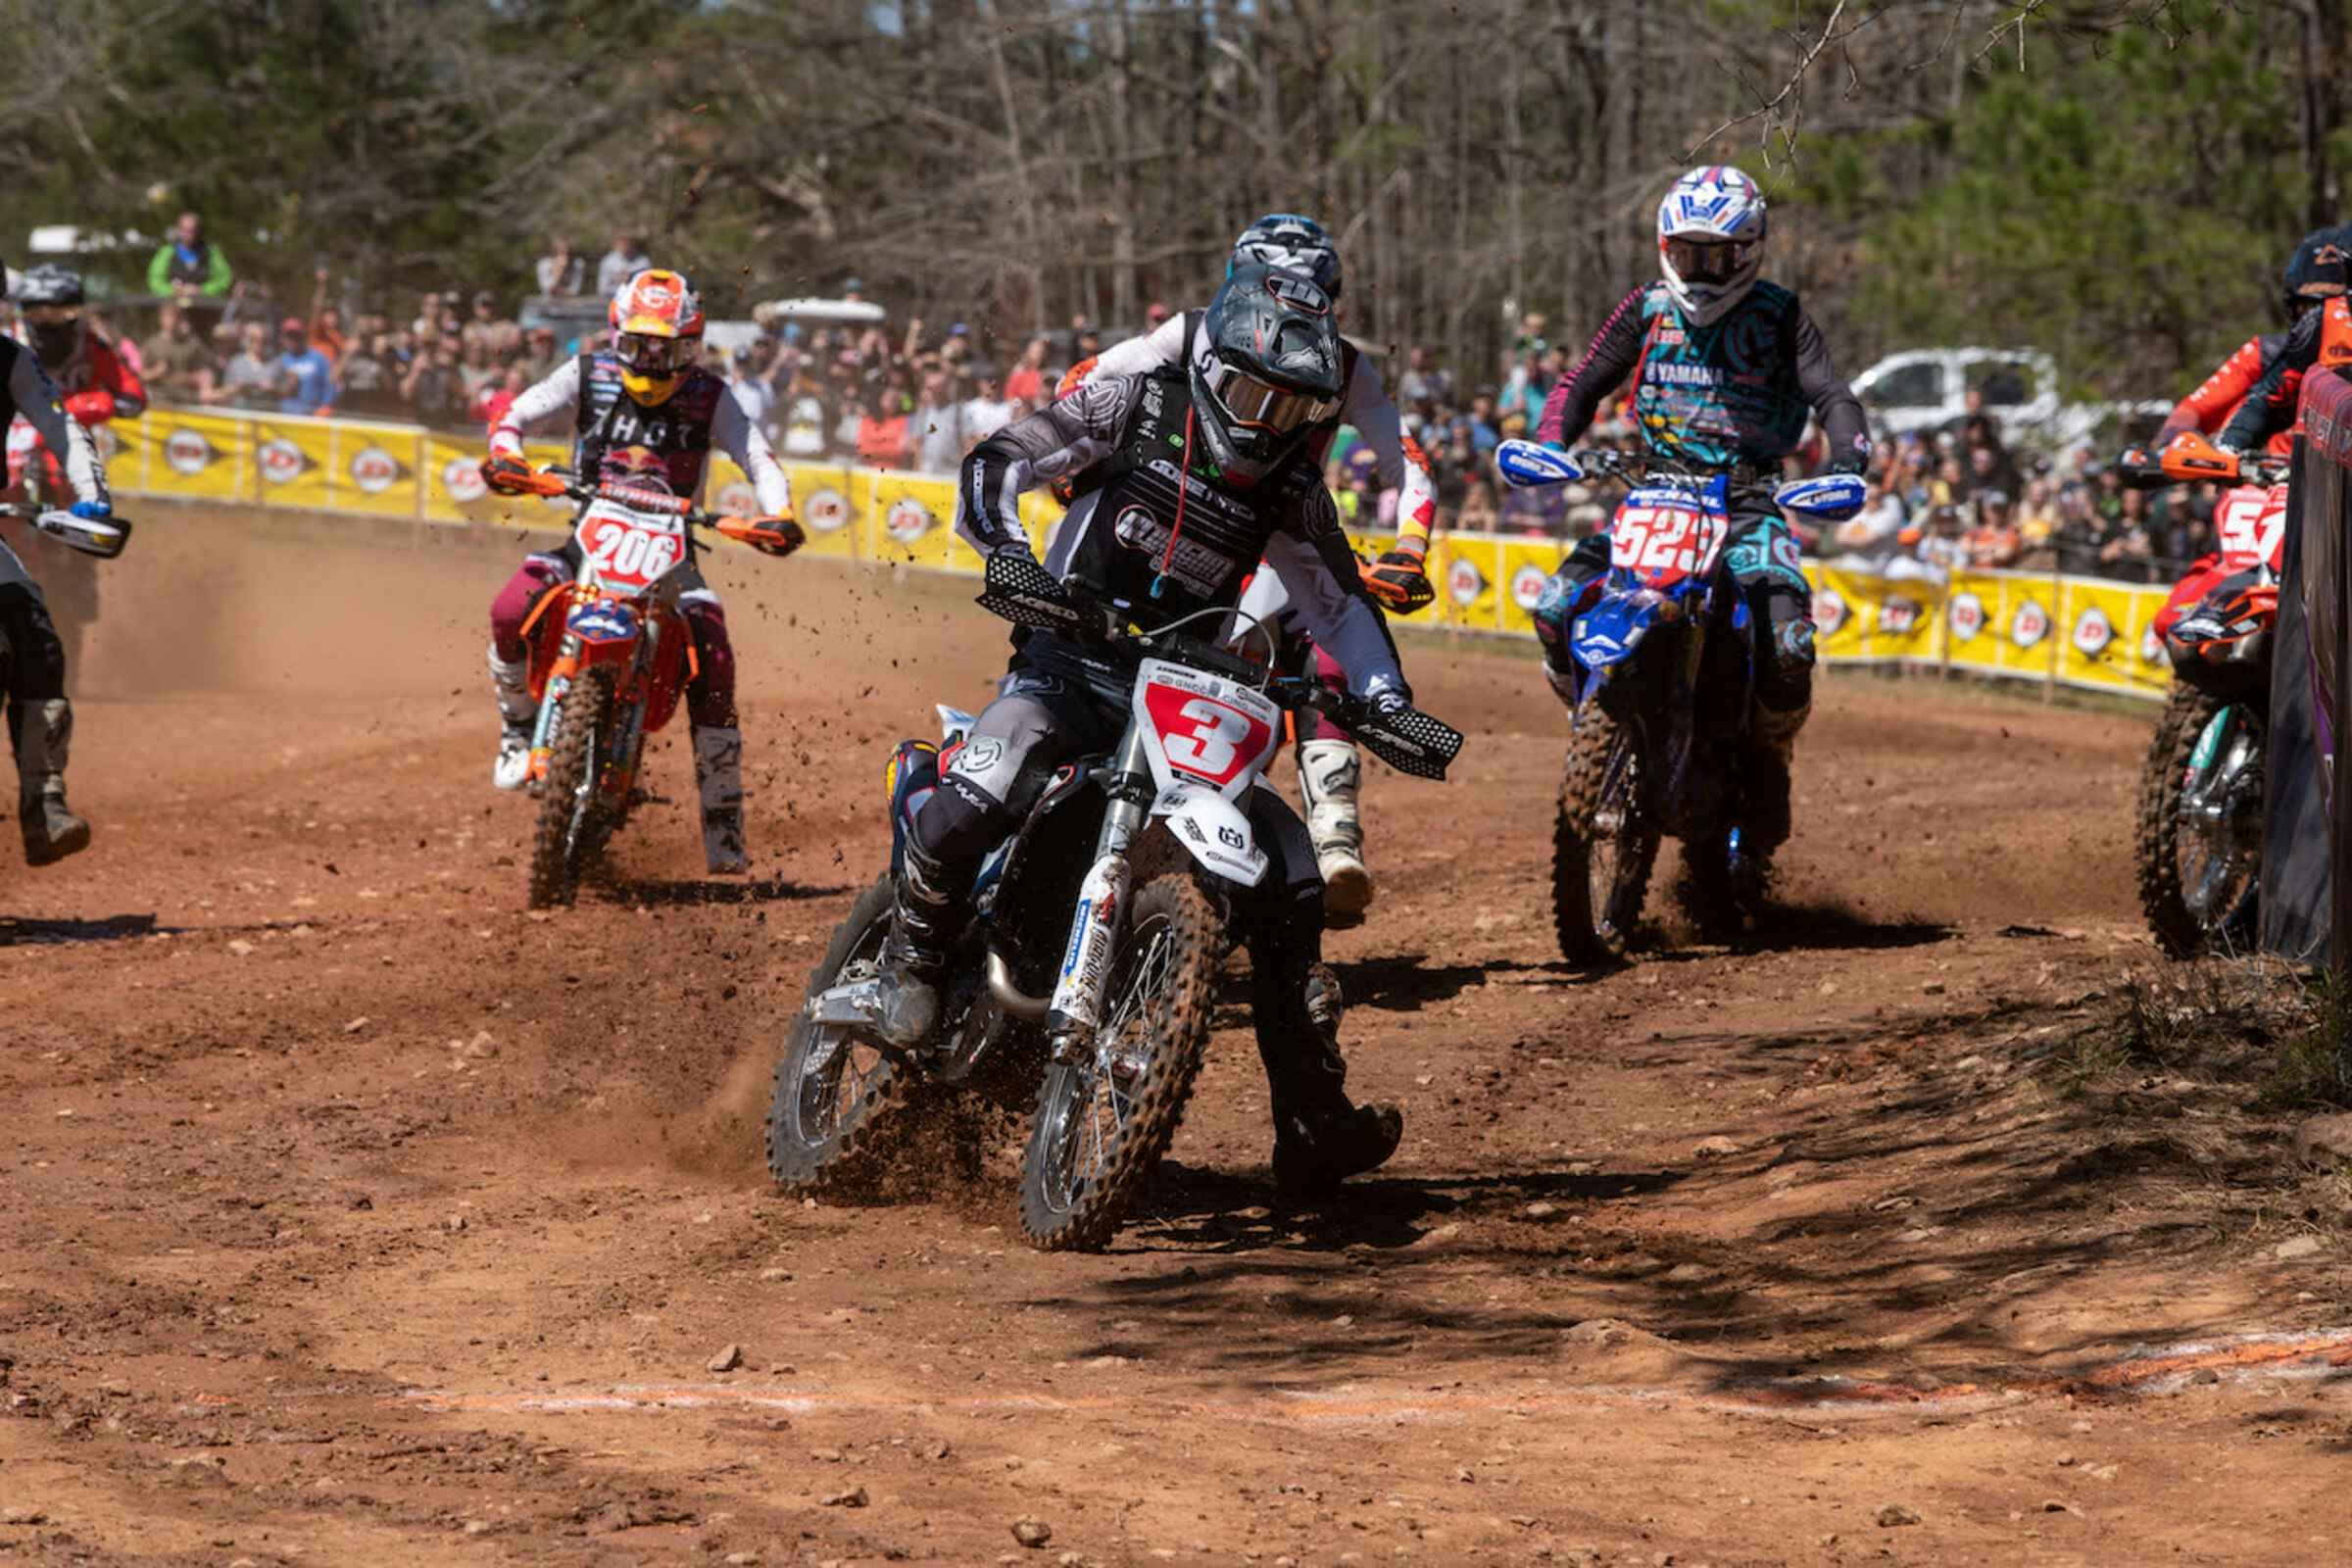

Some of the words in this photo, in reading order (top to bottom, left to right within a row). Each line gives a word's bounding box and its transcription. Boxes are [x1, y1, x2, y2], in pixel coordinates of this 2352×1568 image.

[1657, 363, 1726, 386] YAMAHA
[589, 522, 678, 581] 206
[1611, 509, 1729, 574] 523
[1162, 698, 1252, 776] 3
